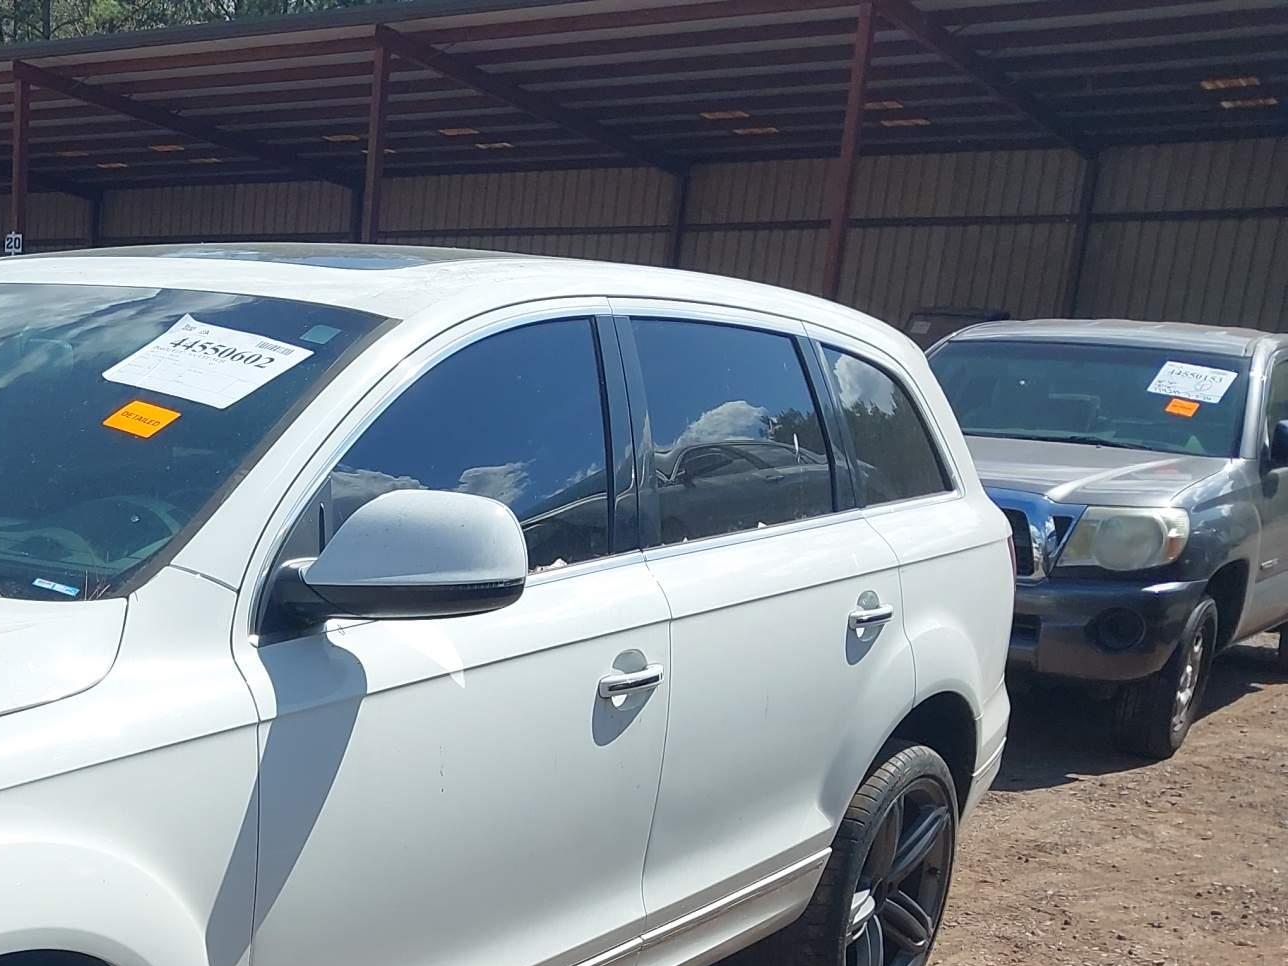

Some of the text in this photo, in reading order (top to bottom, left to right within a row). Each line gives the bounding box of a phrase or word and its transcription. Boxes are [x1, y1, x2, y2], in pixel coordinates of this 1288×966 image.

[6, 236, 21, 250] 20
[169, 337, 275, 369] 44550602
[120, 410, 161, 427] DETAILED
